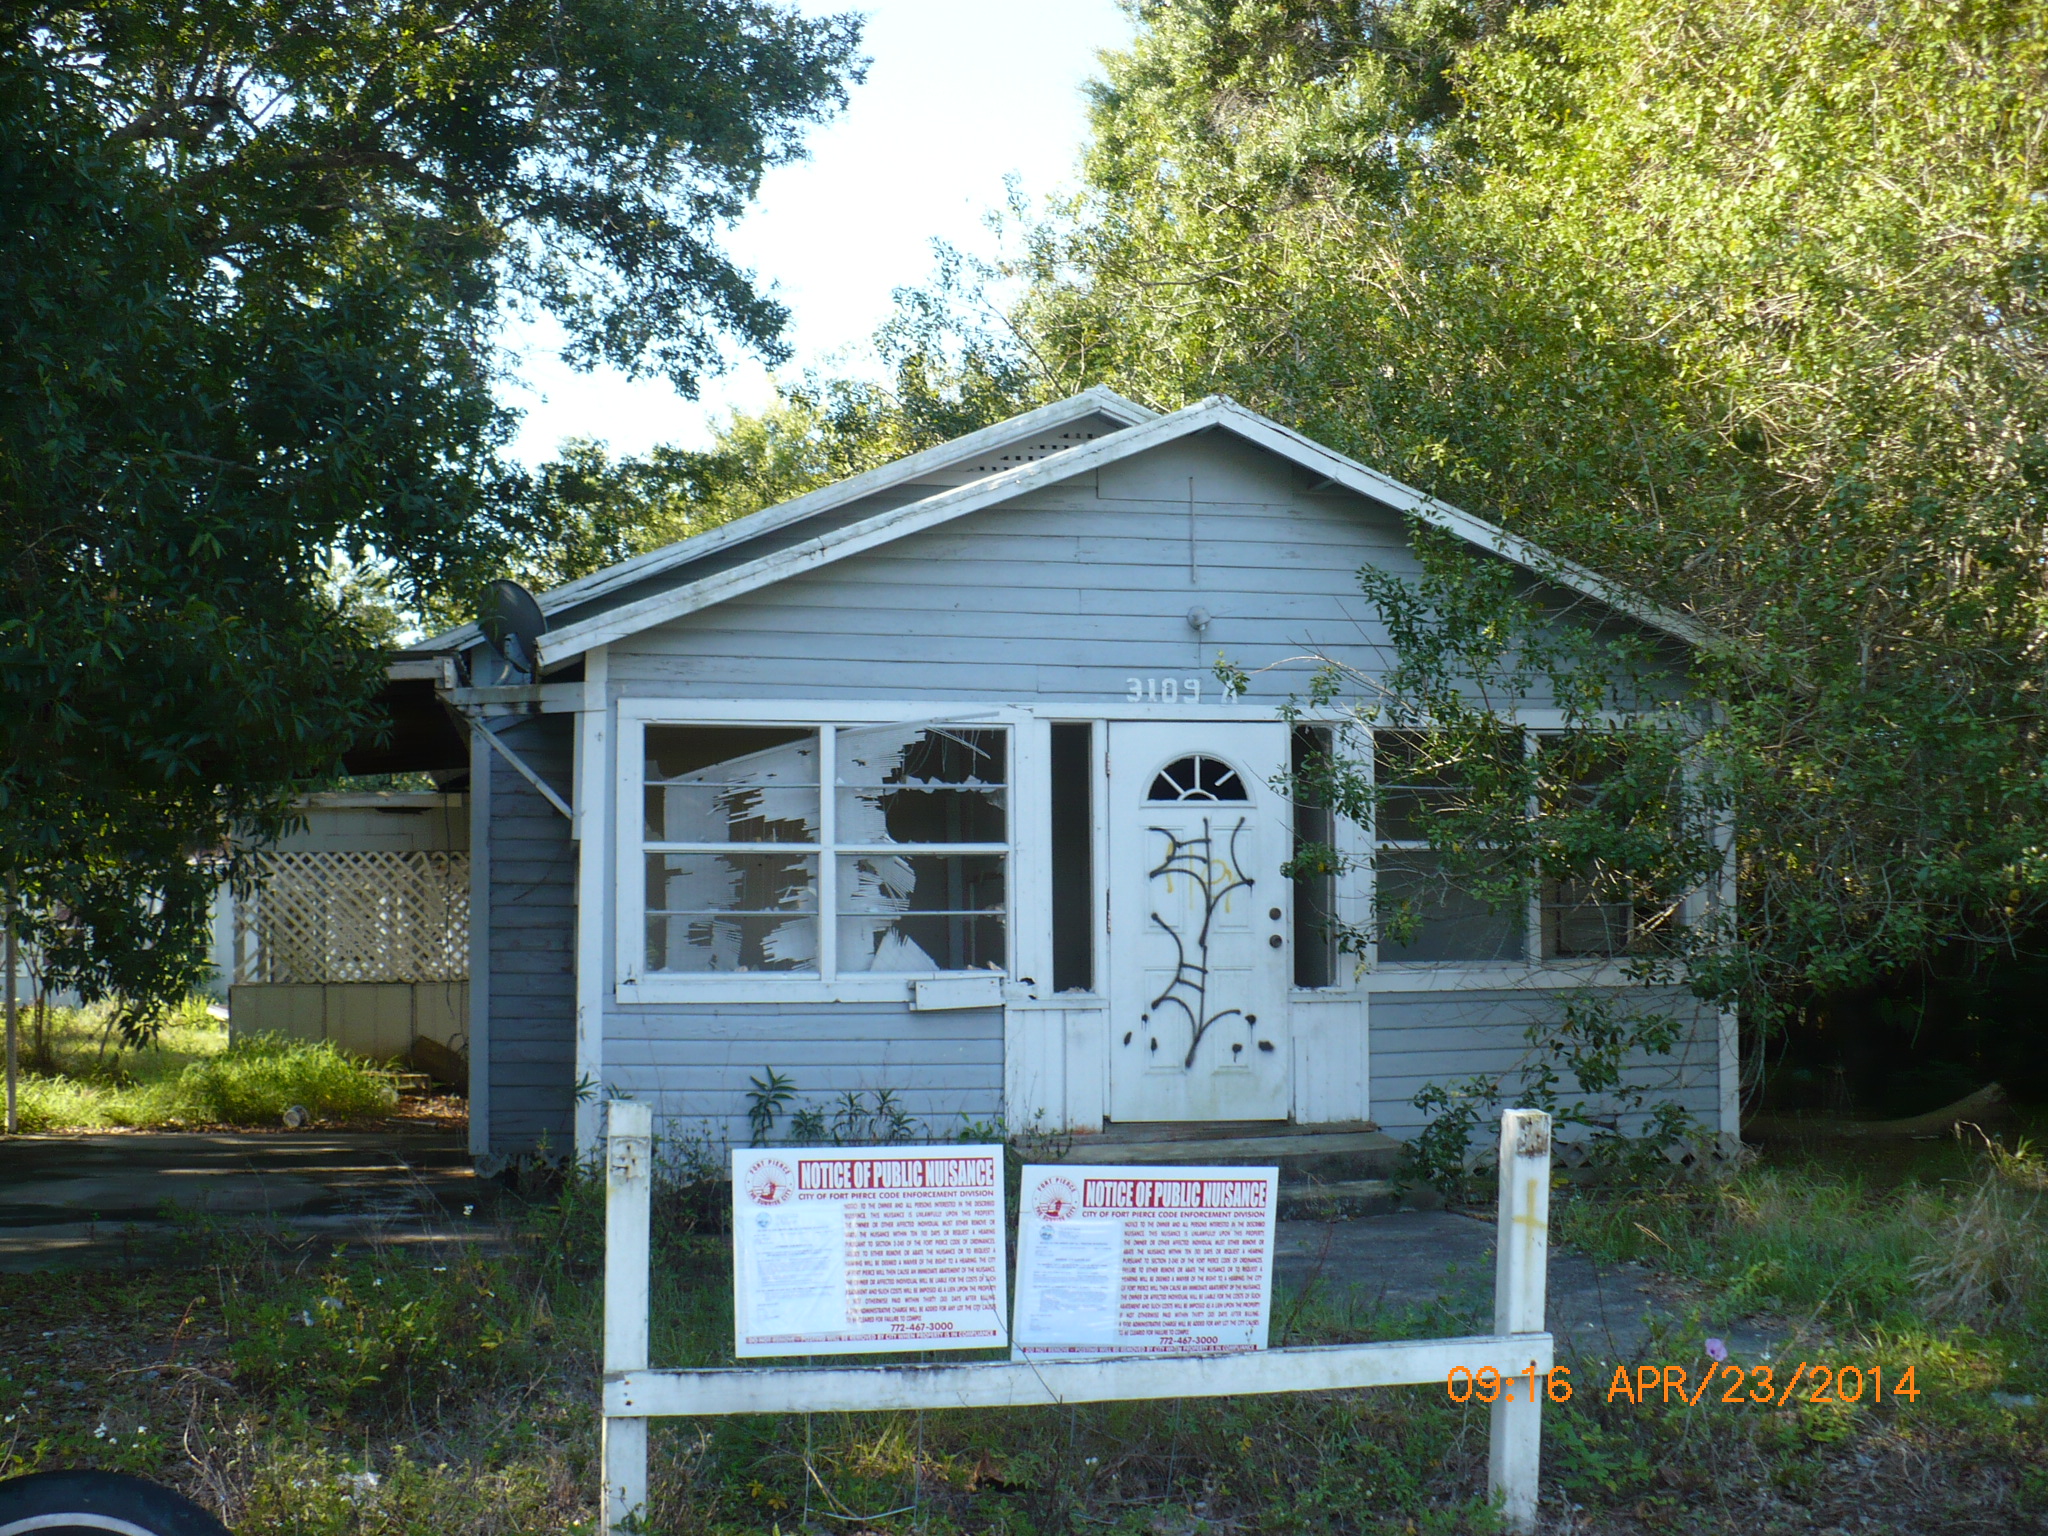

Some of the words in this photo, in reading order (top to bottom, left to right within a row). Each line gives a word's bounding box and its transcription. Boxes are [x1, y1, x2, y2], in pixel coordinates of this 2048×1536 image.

[1126, 677, 1200, 704] 3109
[801, 1162, 852, 1189] NOTICE
[854, 1161, 871, 1188] OF
[872, 1160, 922, 1188] PUBLIC
[925, 1159, 994, 1187] NUISANCE
[902, 1190, 958, 1198] ENFORCEMENT
[1086, 1181, 1134, 1207] NOTICE
[1136, 1181, 1152, 1207] OF
[1154, 1181, 1201, 1207] PUBLIC
[1203, 1181, 1266, 1207] NUISANCE
[891, 1322, 953, 1332] 772-467-3000
[1160, 1336, 1218, 1344] 772-467-3000
